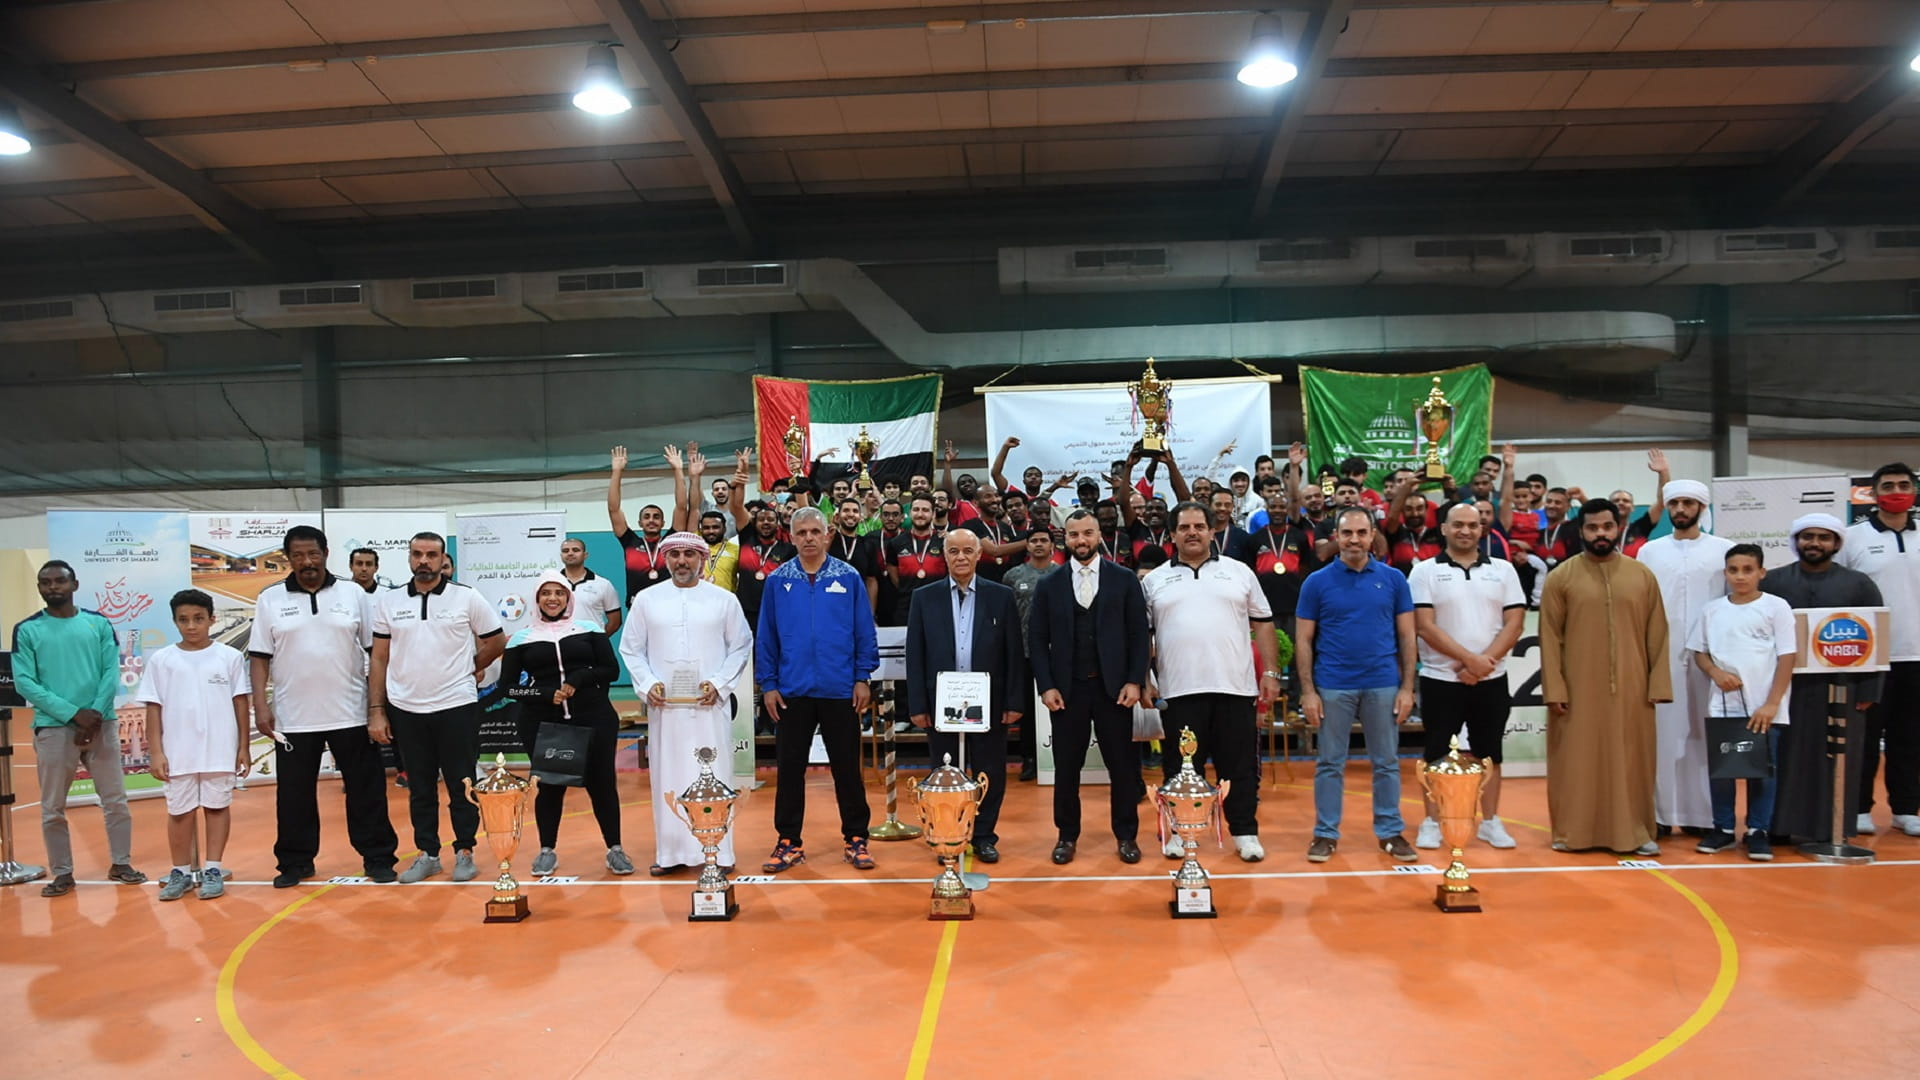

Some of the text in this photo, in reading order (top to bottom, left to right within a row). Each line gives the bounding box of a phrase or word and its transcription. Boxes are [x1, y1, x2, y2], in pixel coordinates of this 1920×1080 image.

[1824, 622, 1859, 640] نبيل
[1511, 635, 1544, 706] 2
[509, 688, 541, 696] BARREL
